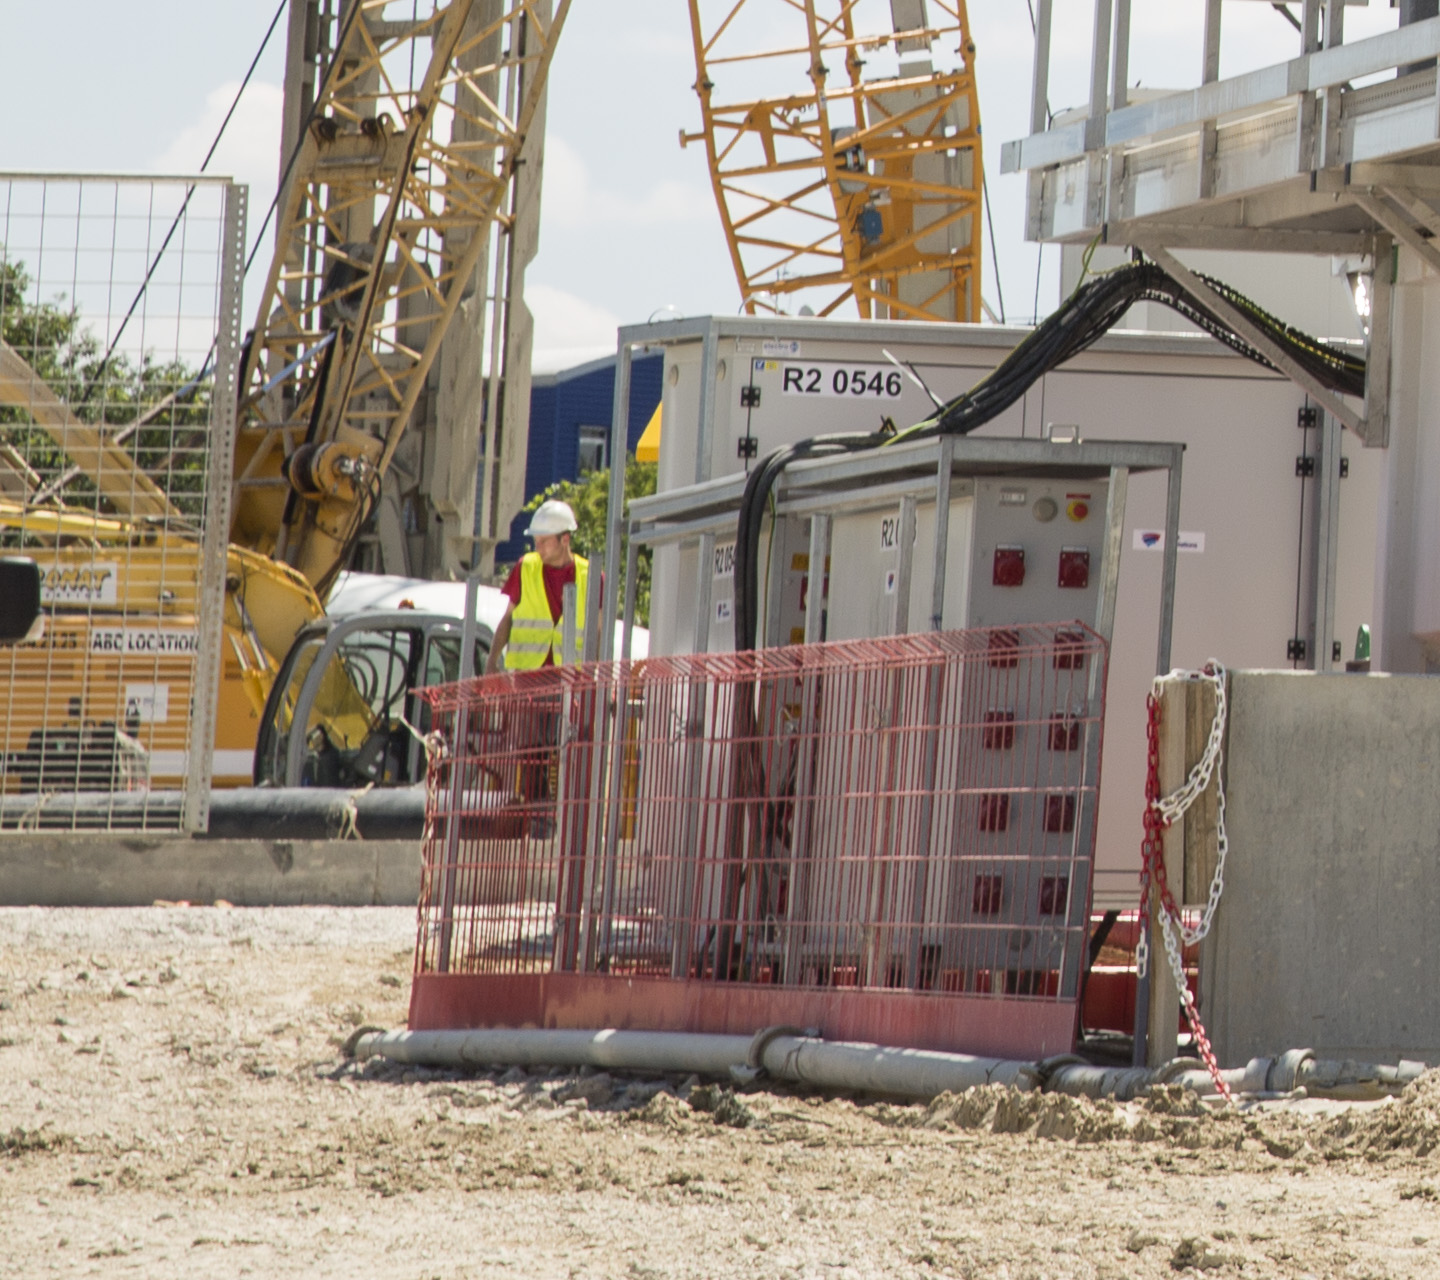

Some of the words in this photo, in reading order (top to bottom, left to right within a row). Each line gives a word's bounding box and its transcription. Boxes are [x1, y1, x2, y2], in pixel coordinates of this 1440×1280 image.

[783, 368, 822, 393] R2
[832, 369, 902, 397] 0546
[881, 518, 894, 548] R2
[93, 632, 123, 650] ABC
